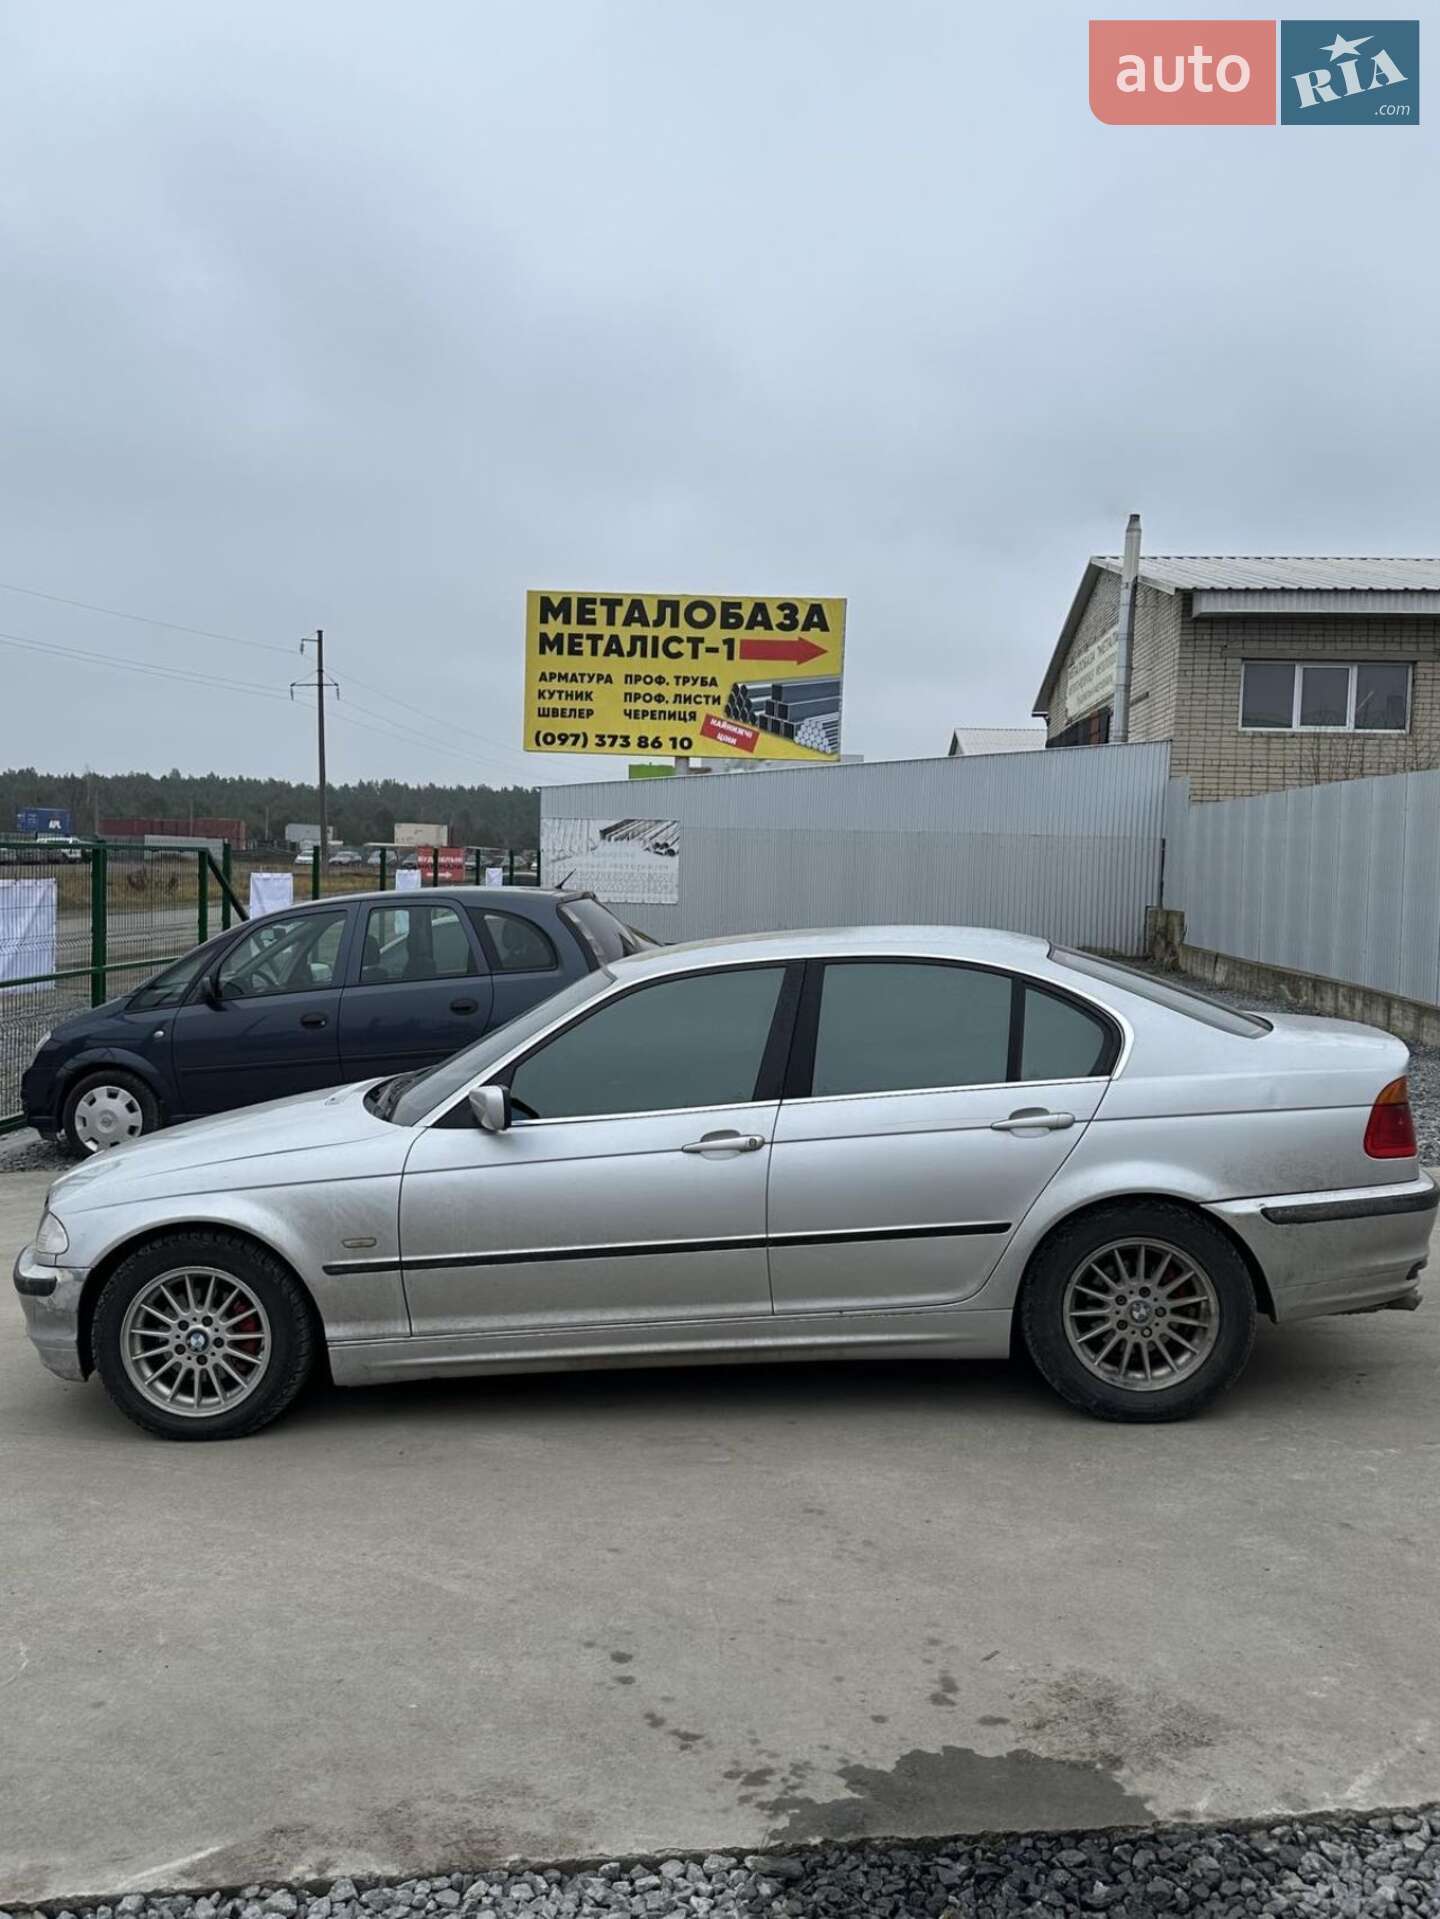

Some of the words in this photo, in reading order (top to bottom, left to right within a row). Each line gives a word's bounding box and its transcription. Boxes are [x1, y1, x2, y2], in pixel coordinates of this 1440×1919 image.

[539, 596, 830, 632] МЕТАЛОБАЗА
[538, 632, 735, 661] МЕТАЛІСТ-1
[538, 672, 613, 684] АРМАТУРА
[624, 674, 670, 686] ПРОФ.
[673, 675, 718, 688] ТРУБА
[537, 689, 593, 701] КУТНИК
[624, 692, 669, 704] ПРОФ.
[673, 693, 721, 706] ЛИСТИ
[537, 707, 594, 719] ШВЕЛЕР
[623, 709, 697, 723] ЧЕРЕПИЦЯ
[535, 730, 588, 748] (097)
[595, 733, 631, 748] 373
[637, 735, 663, 749] 86
[669, 736, 693, 750] 10
